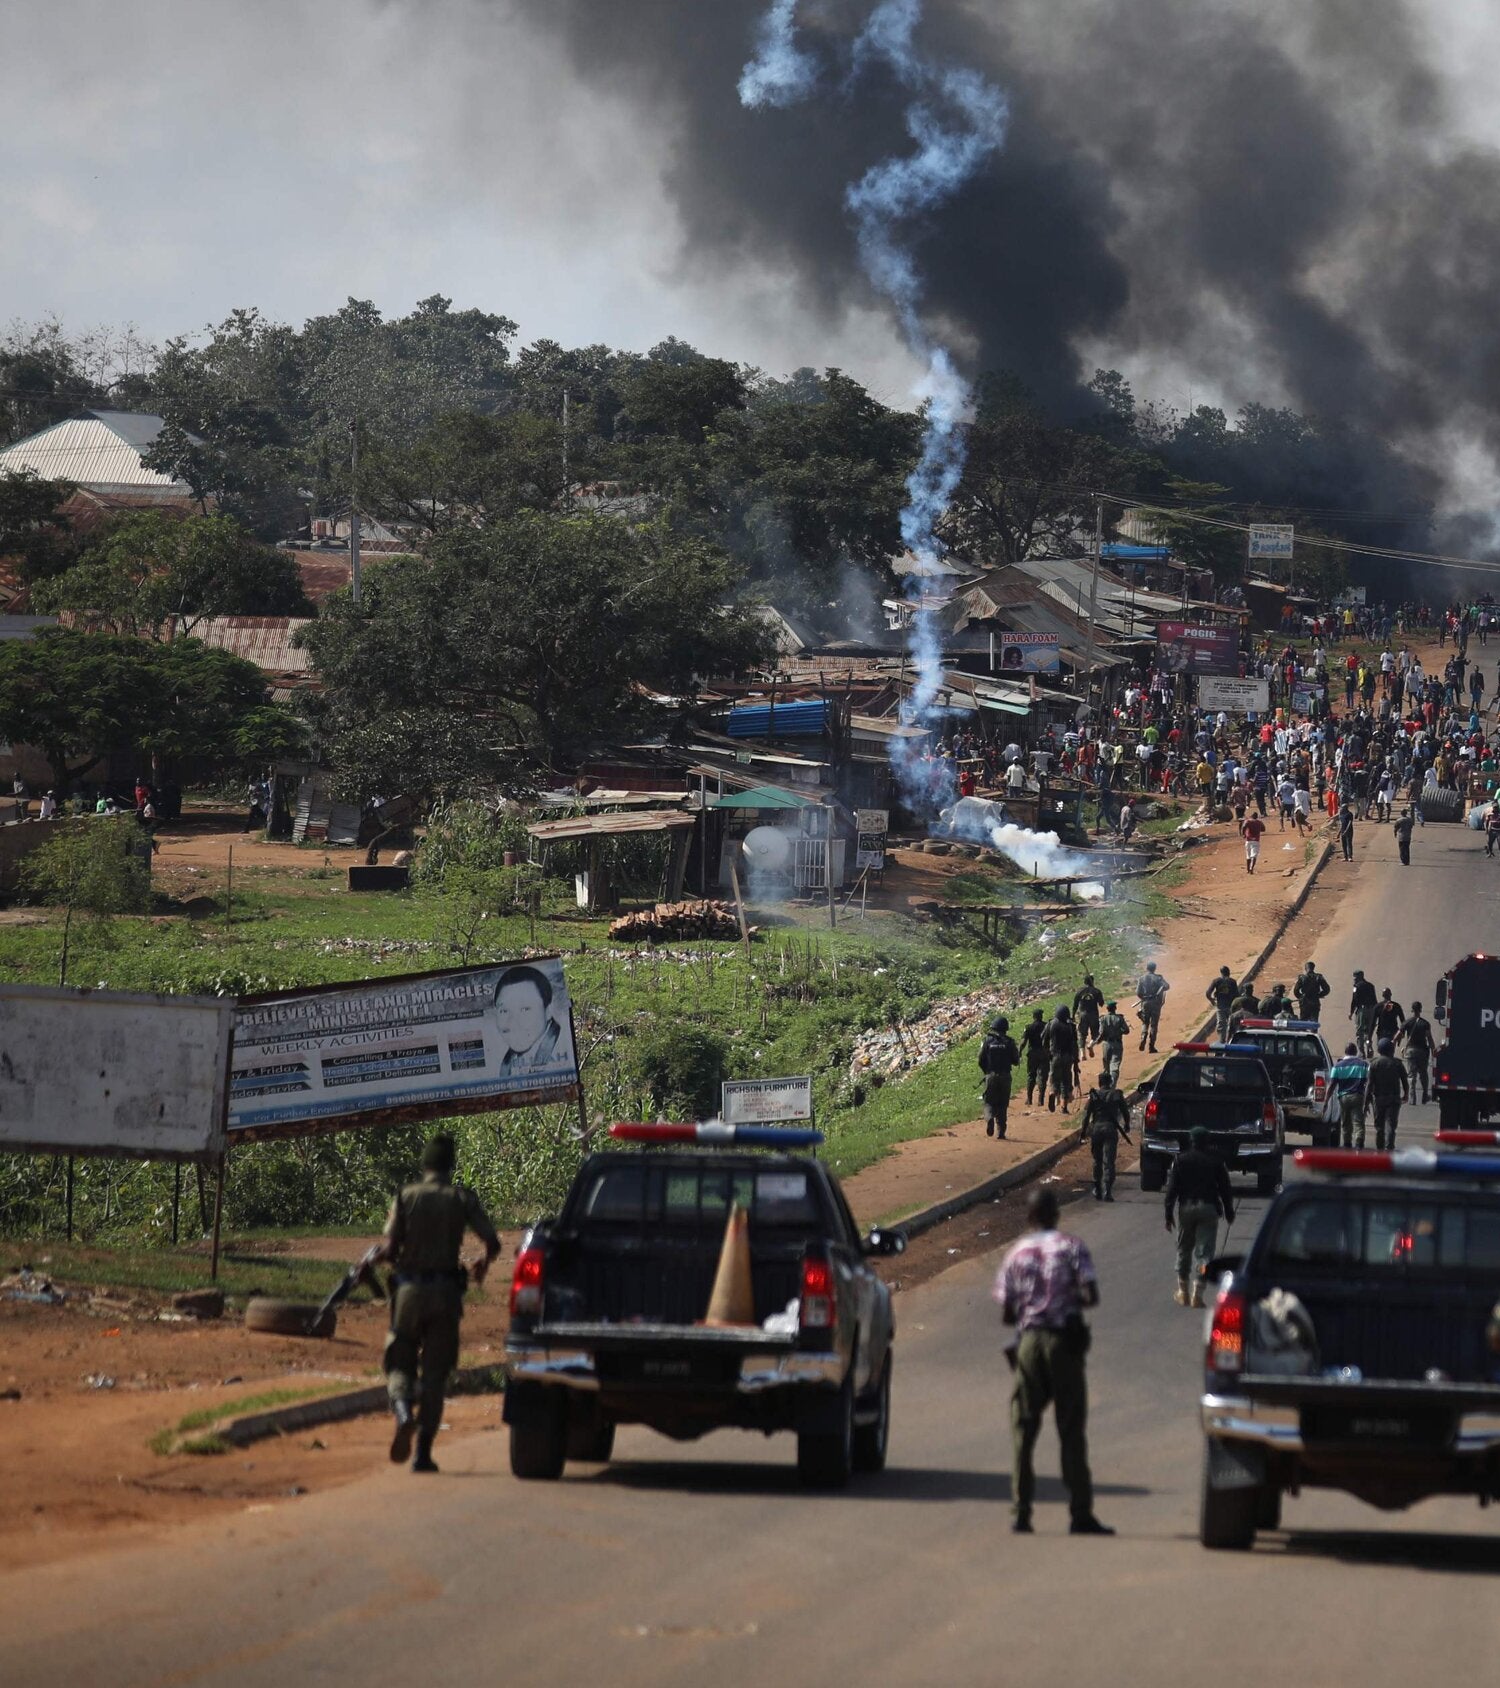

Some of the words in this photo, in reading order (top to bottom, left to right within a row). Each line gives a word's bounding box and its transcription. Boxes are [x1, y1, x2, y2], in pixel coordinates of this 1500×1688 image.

[1003, 633, 1030, 643] HARA
[1032, 633, 1058, 643] FOAM
[242, 1003, 331, 1026] BELIEVER'S
[335, 998, 370, 1014] FIRE
[374, 993, 407, 1009] AND
[411, 983, 494, 1004] MIRACLES
[308, 1008, 388, 1030] MINISTRY
[262, 1039, 325, 1056] WEEKLY
[330, 1027, 414, 1048] ACTIVITIES
[247, 1069, 256, 1077] &
[260, 1065, 299, 1075] Friday
[324, 1065, 359, 1076] Healing
[326, 1075, 362, 1087] Healing
[364, 1072, 382, 1080] and
[384, 1065, 438, 1078] Deliverance
[264, 1084, 304, 1095] Service
[726, 1085, 762, 1094] RICHSON
[764, 1081, 809, 1092] FURNITURE
